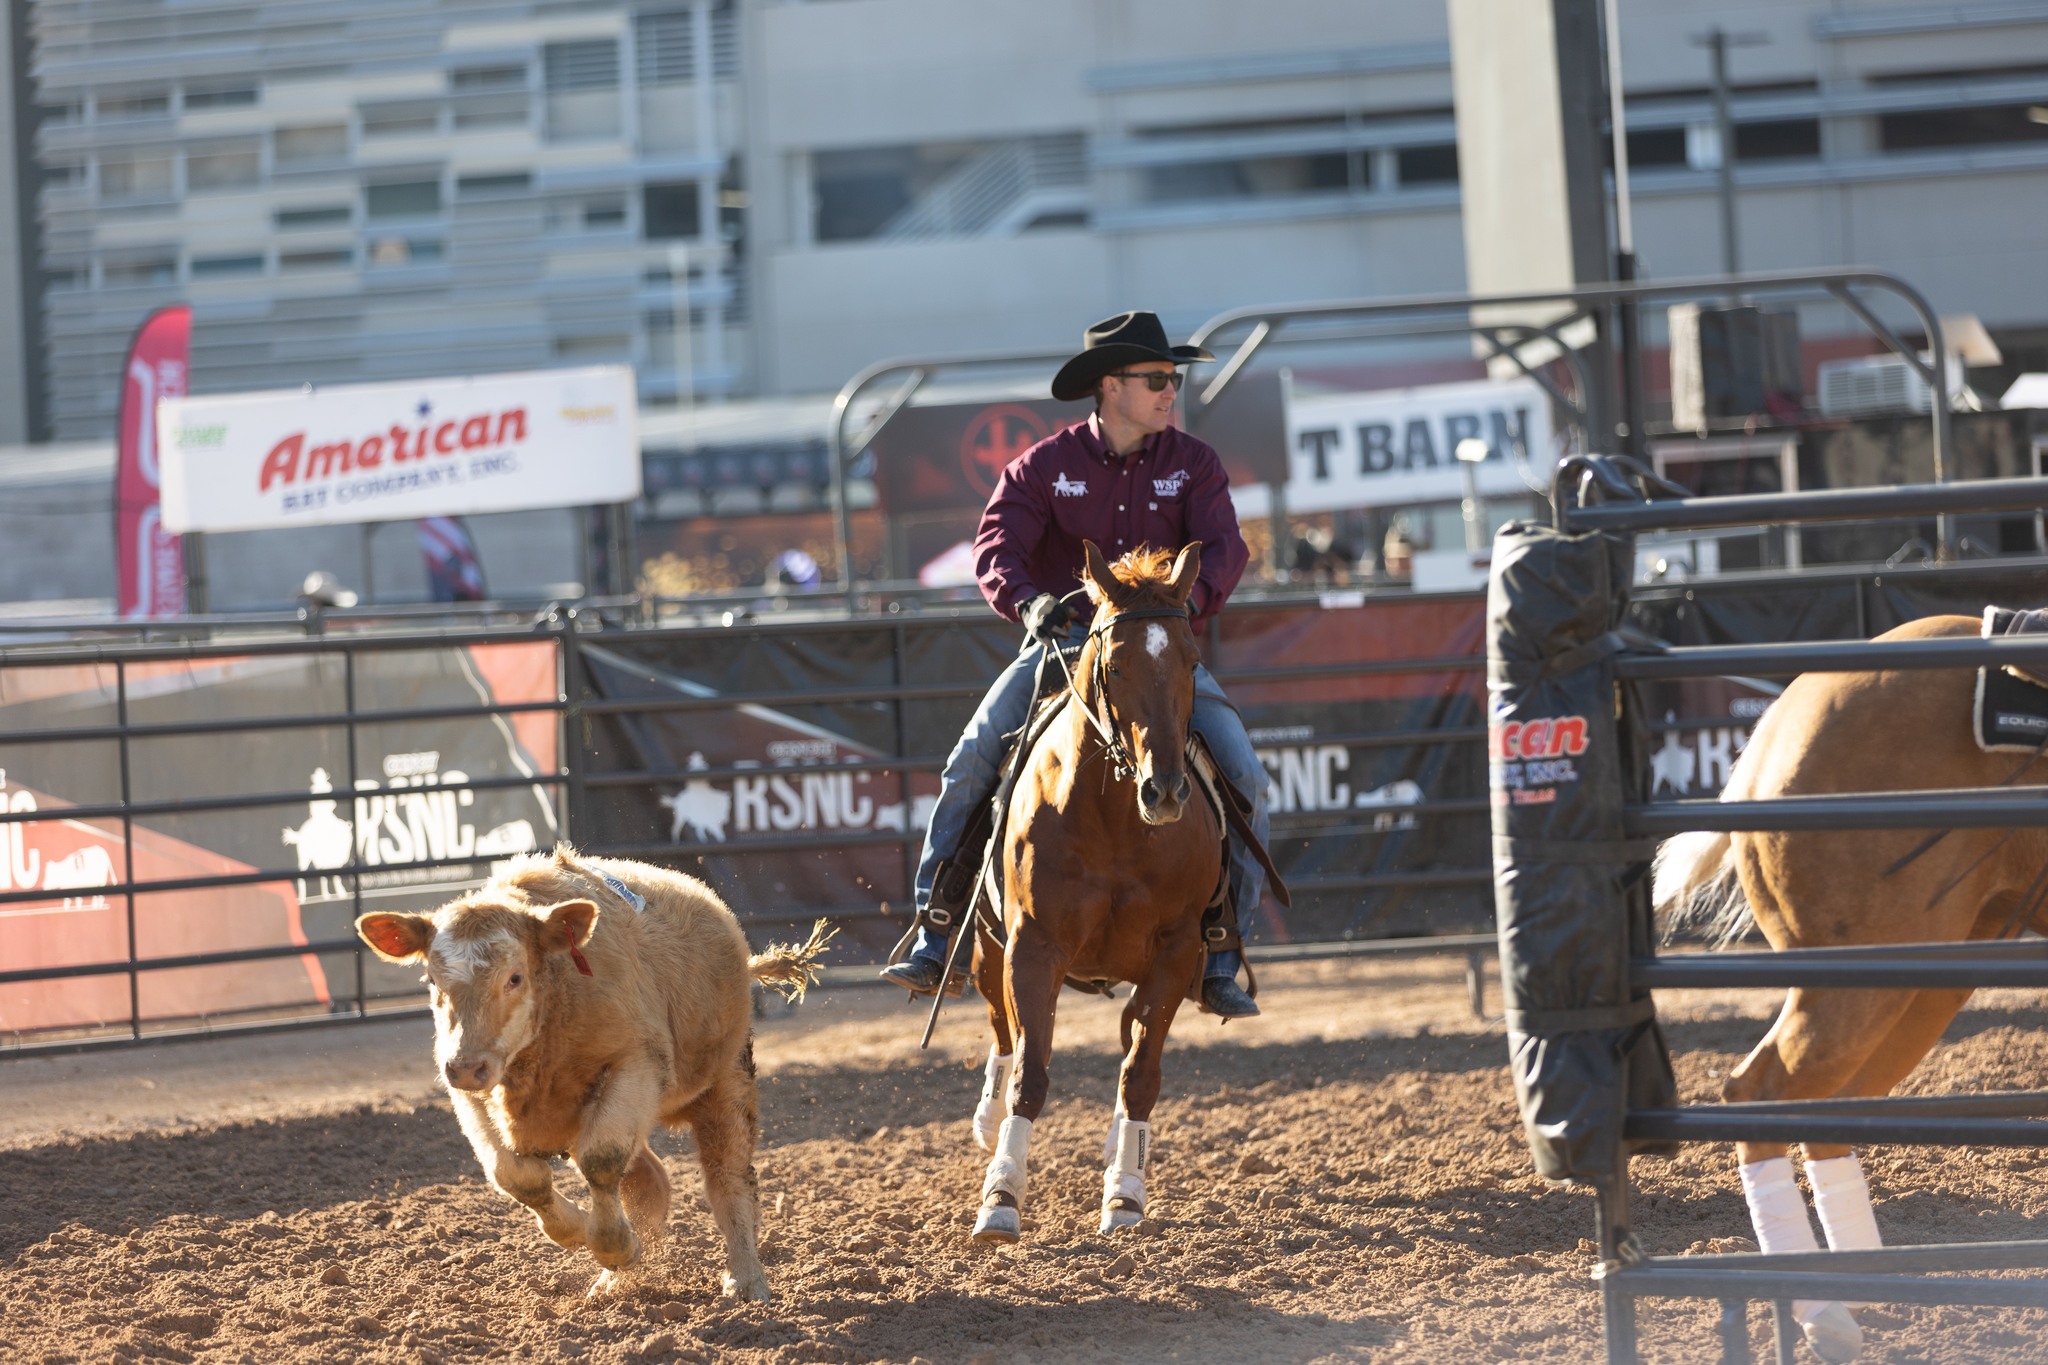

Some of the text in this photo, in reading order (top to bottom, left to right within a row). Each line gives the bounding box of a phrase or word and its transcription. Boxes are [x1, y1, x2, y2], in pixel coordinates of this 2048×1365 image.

[259, 405, 529, 492] American
[1299, 408, 1530, 480] T BARN
[1152, 479, 1181, 491] WSP
[355, 771, 475, 866] RSNC
[734, 756, 873, 831] RSNC
